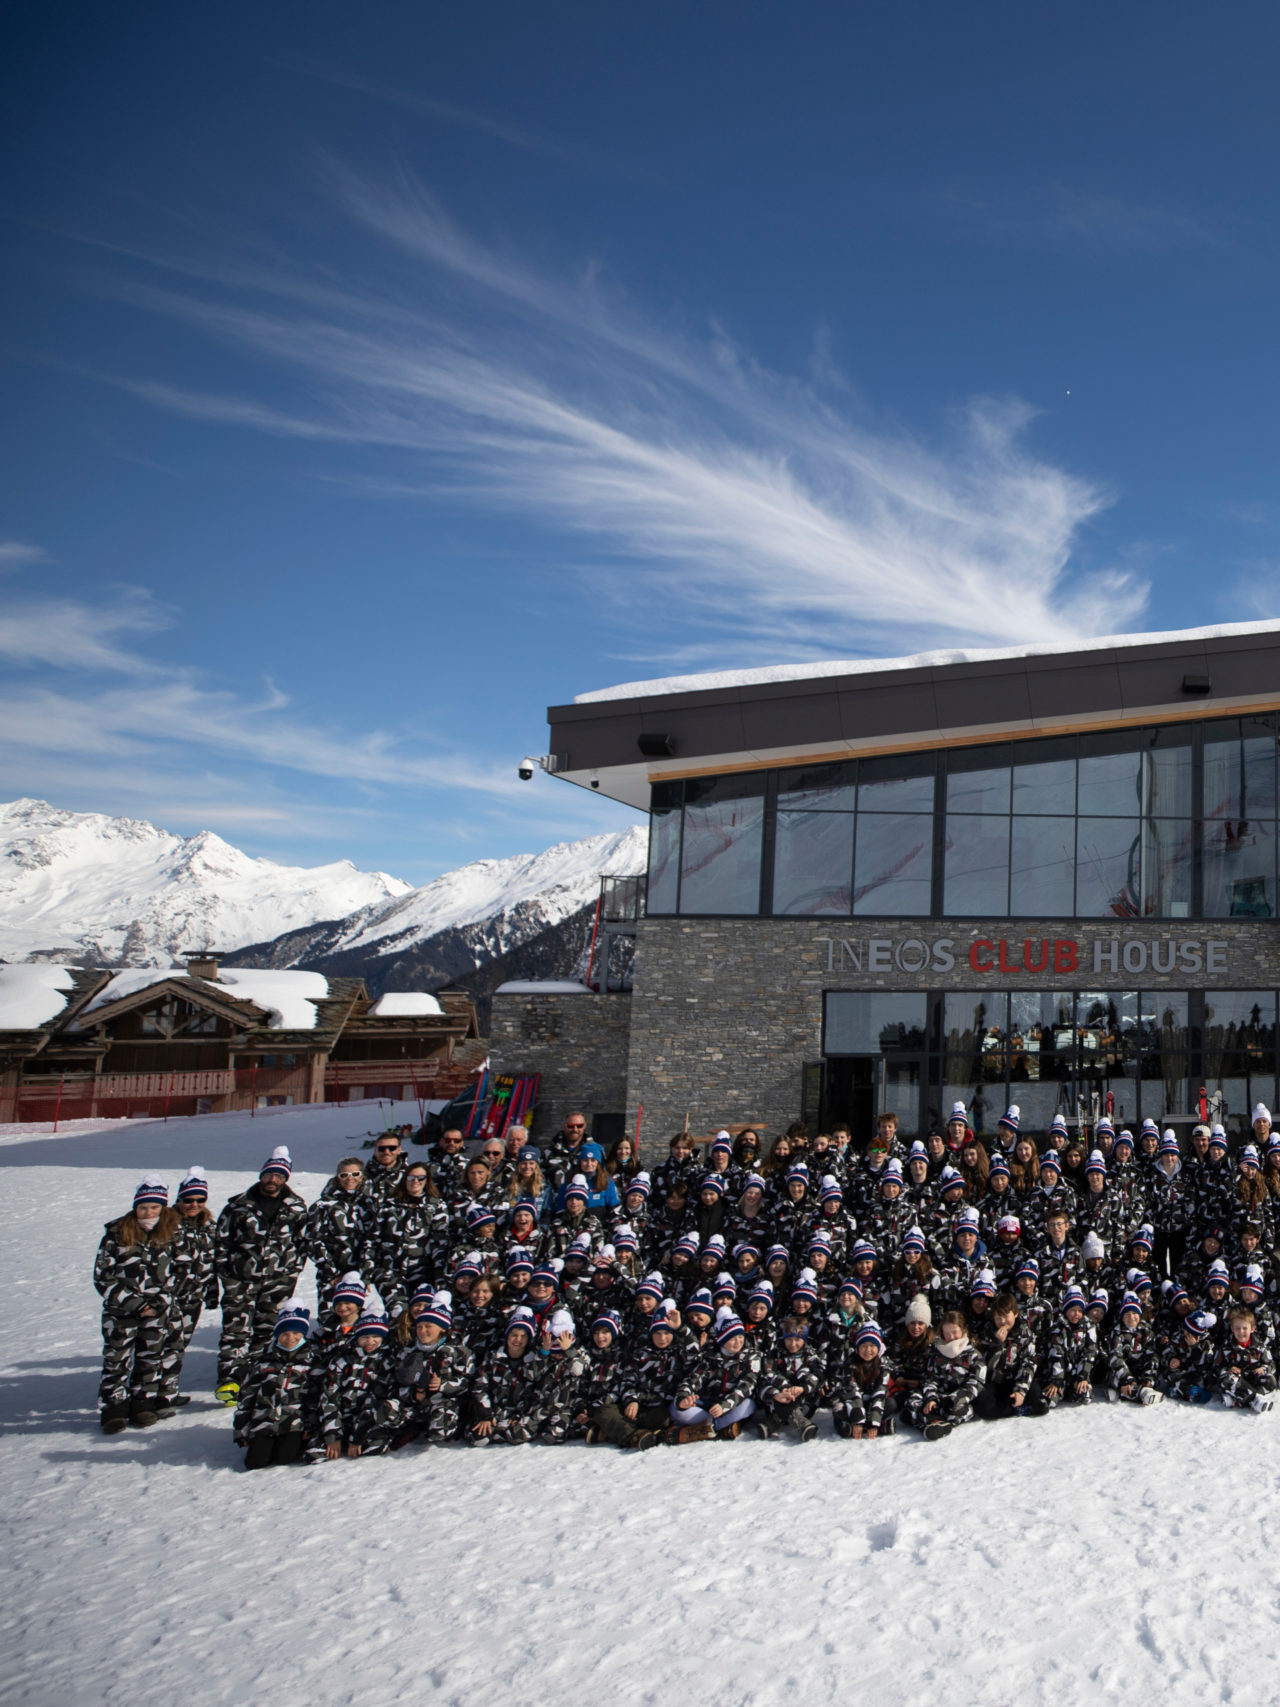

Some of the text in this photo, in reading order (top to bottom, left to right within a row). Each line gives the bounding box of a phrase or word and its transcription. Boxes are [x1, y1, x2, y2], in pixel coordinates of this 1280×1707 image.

[825, 939, 1229, 974] INEOS CLUB HOUSE
